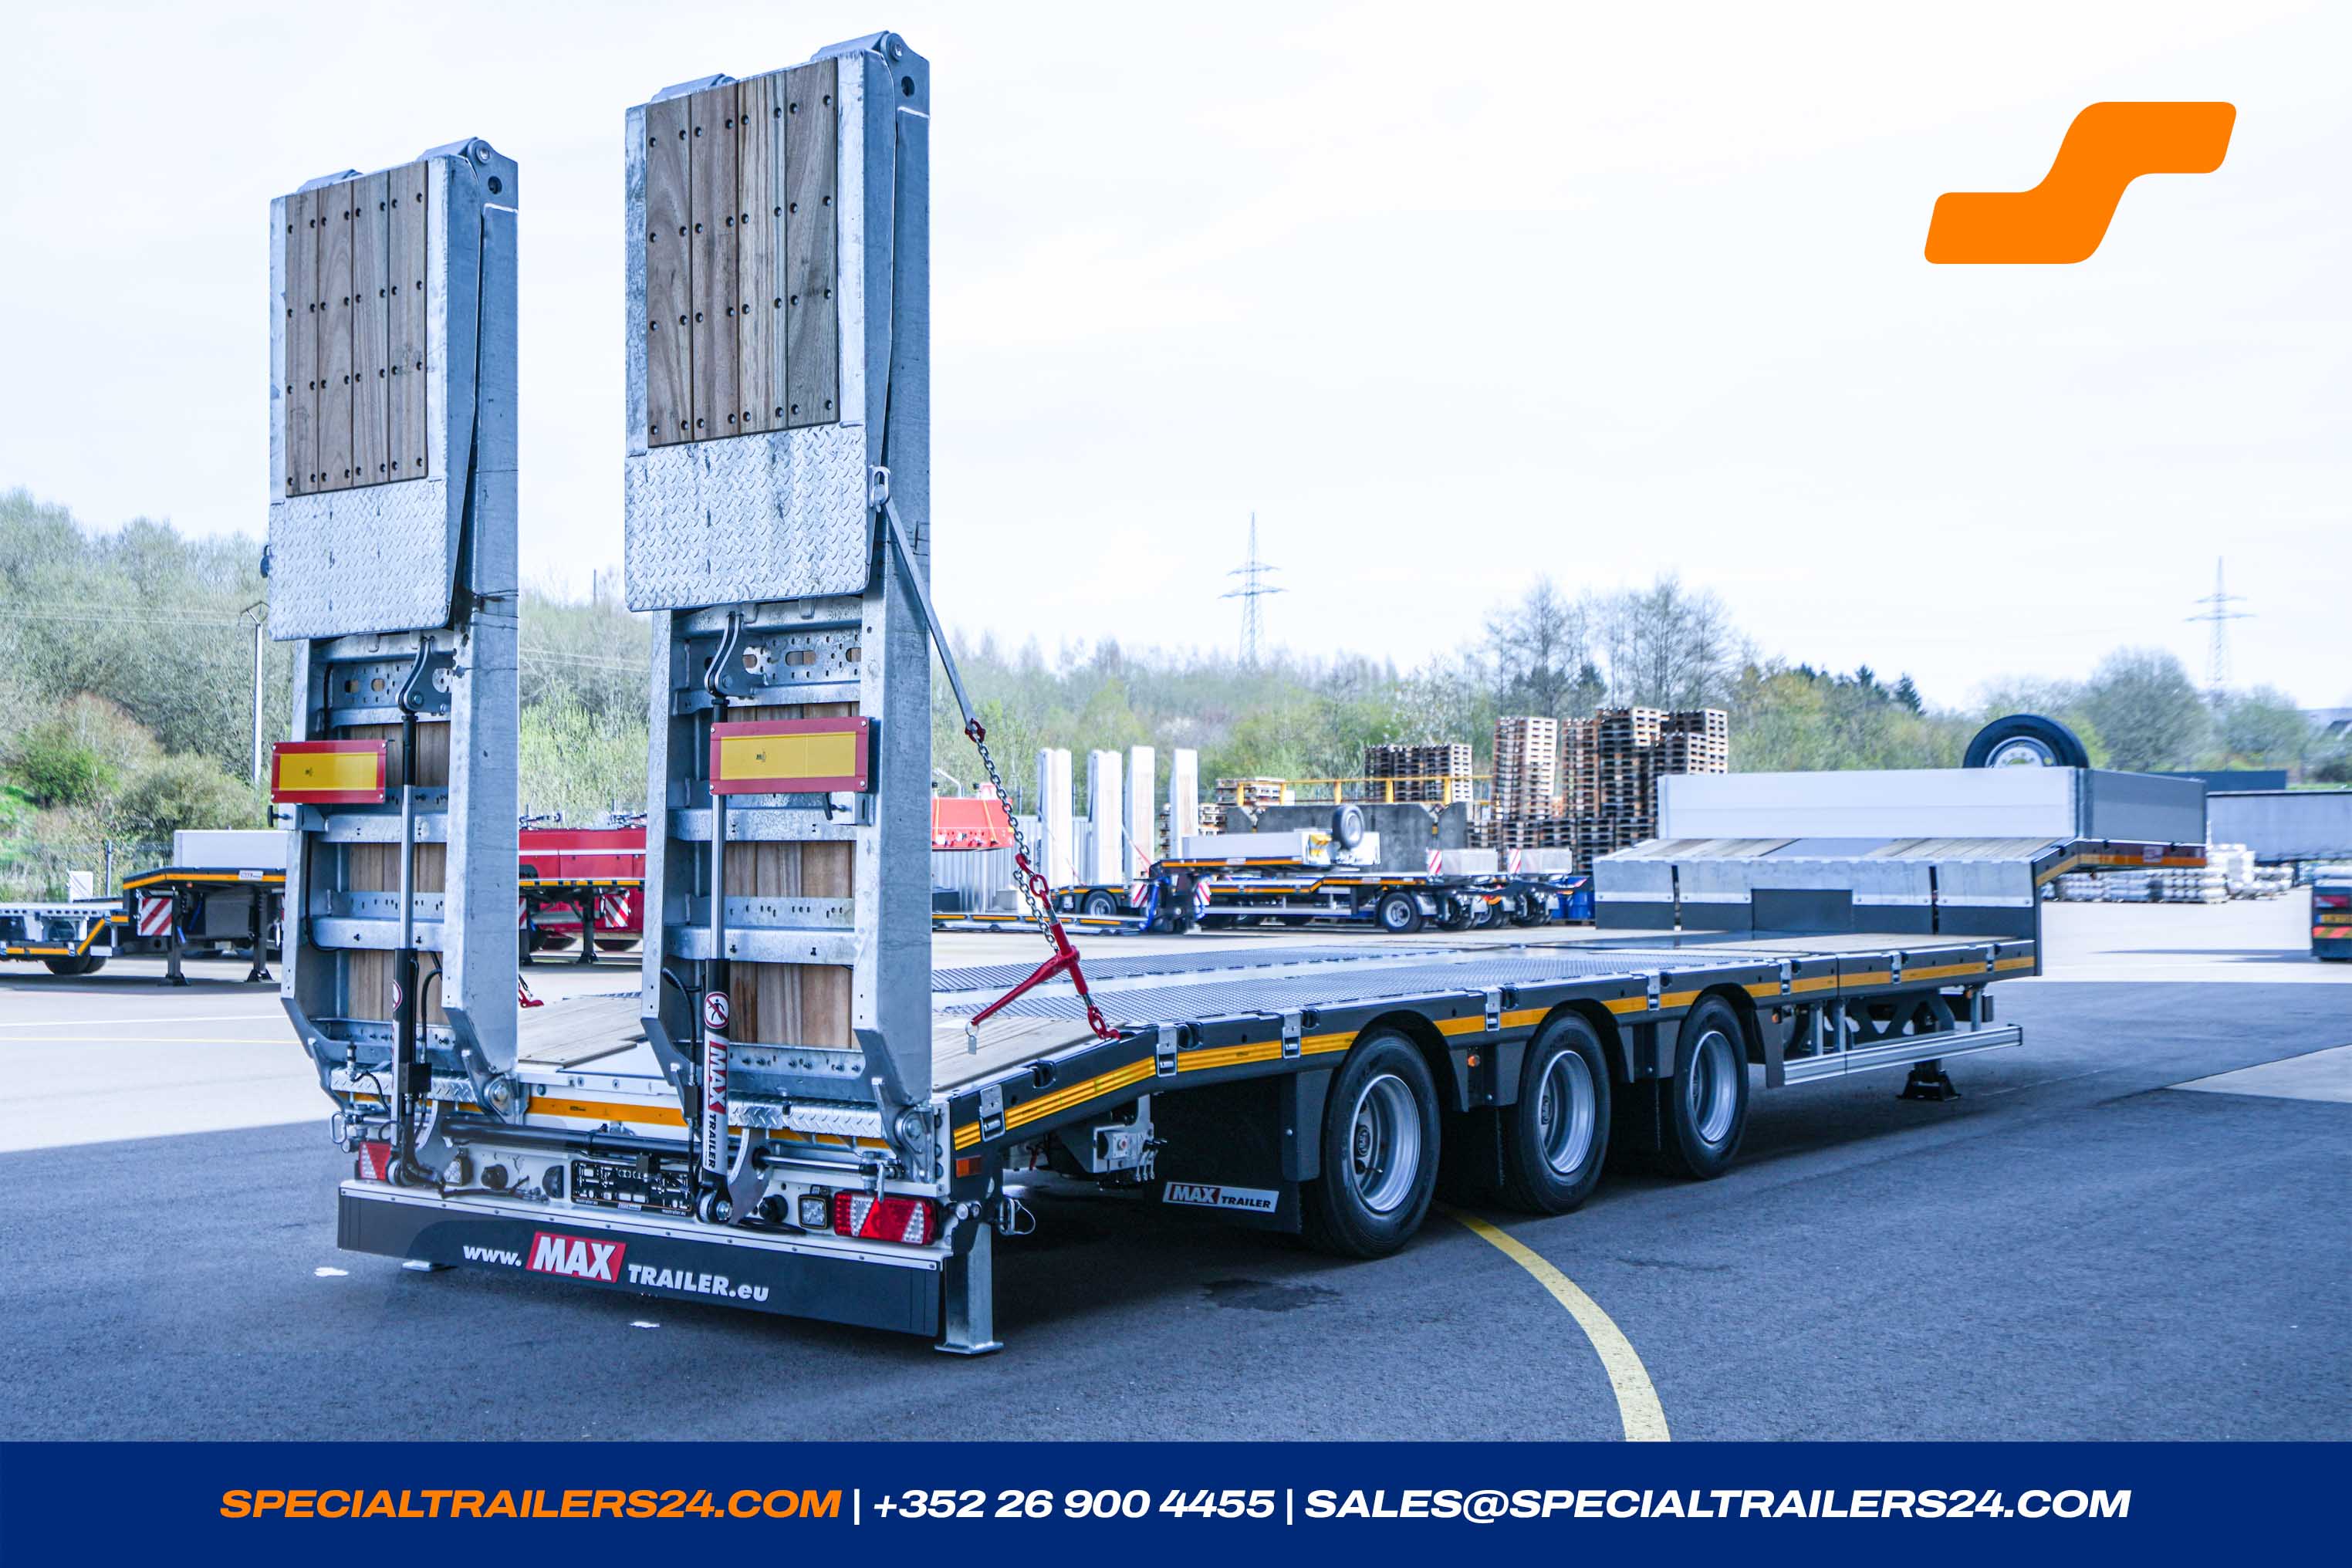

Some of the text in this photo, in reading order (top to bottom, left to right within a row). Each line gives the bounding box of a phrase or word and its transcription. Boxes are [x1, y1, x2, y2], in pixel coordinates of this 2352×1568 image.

[708, 1046, 728, 1168] MAX TRAILER
[1172, 1184, 1271, 1208] MAX TRAILER
[463, 1235, 770, 1303] www. MAX TRAILER.eu
